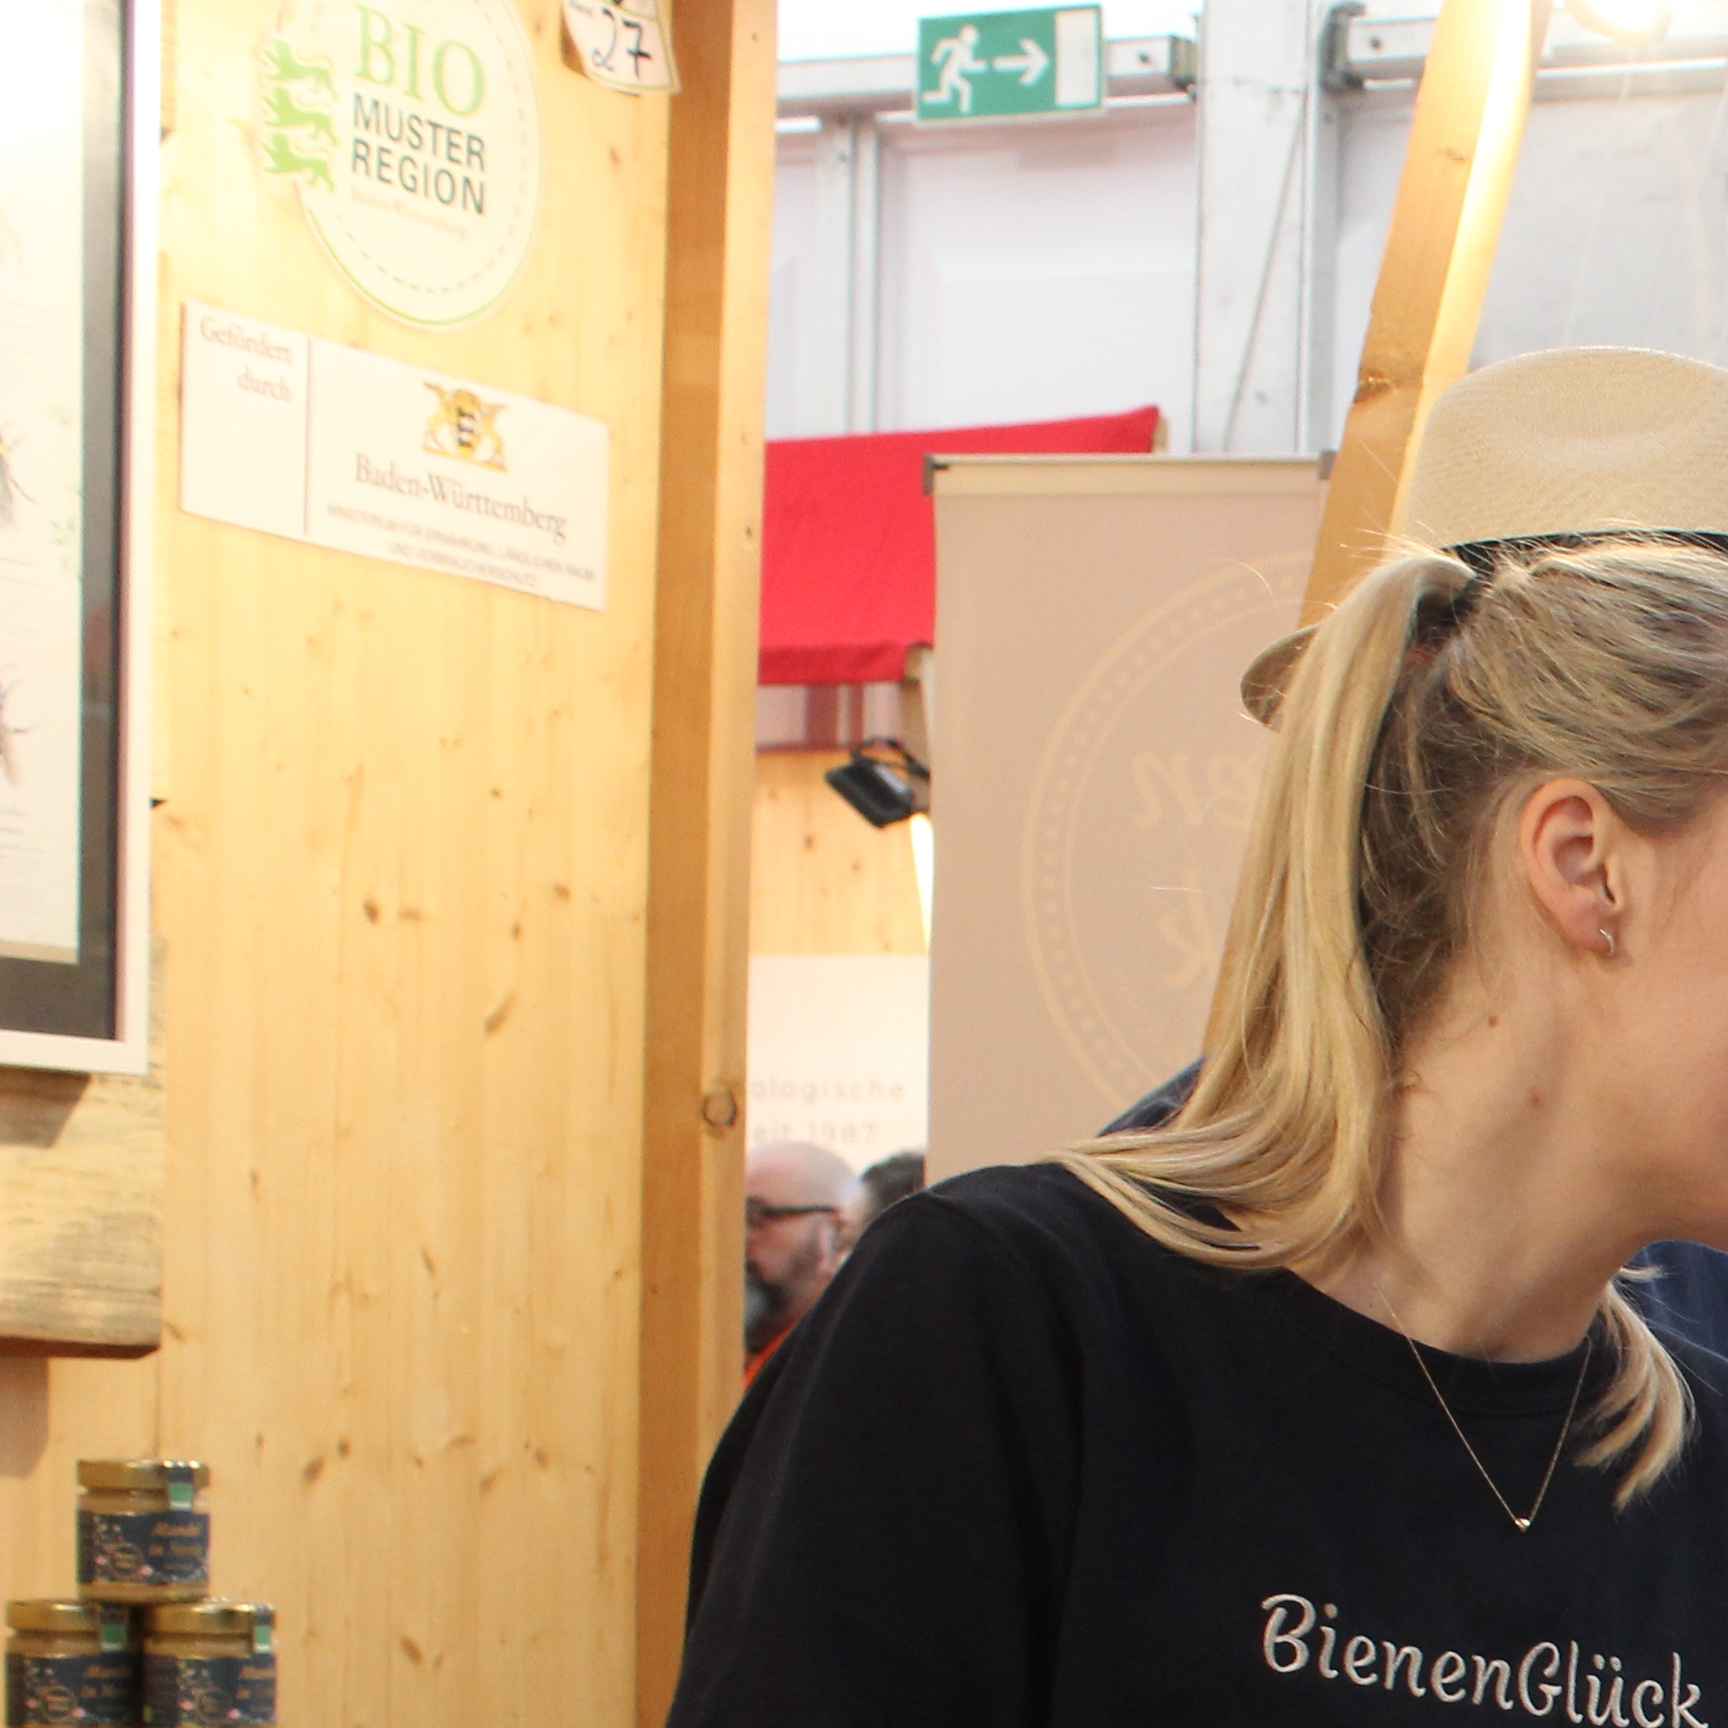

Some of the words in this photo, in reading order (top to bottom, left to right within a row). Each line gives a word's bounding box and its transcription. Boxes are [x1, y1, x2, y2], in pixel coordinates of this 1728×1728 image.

[354, 3, 486, 117] BIO
[352, 92, 486, 172] MUSTER
[350, 137, 486, 215] REGION
[200, 316, 292, 365] Gefördert
[236, 366, 292, 403] durch
[354, 452, 569, 544] Baden-Württemberg
